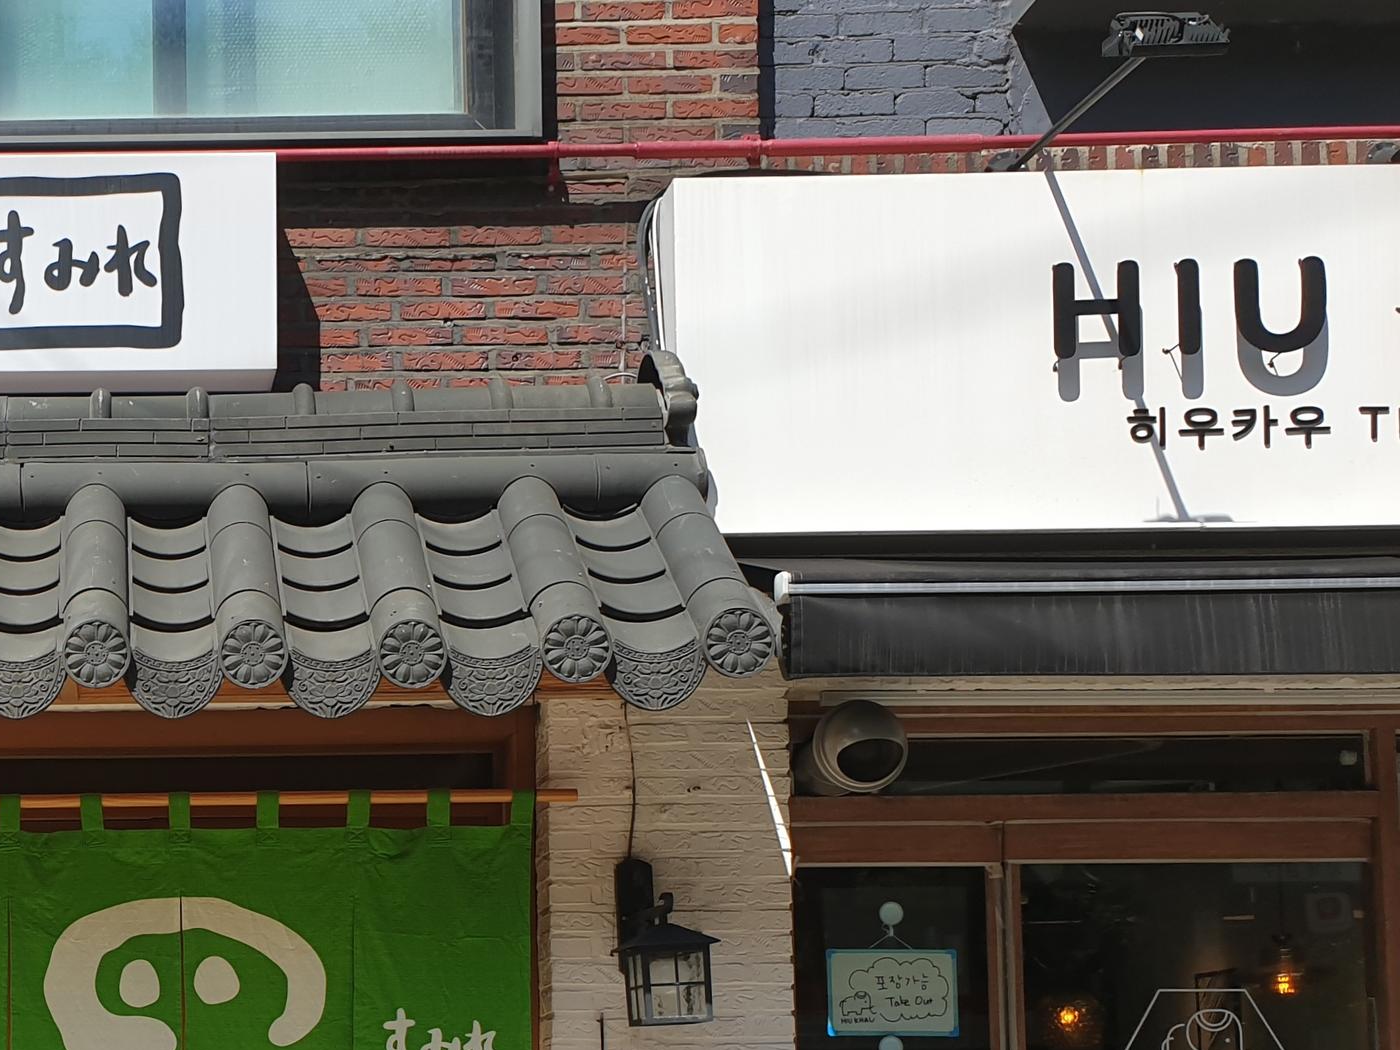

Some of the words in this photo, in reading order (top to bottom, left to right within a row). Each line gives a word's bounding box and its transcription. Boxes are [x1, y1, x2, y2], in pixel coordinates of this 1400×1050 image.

[1052, 256, 1328, 359] HIU
[1126, 405, 1331, 450] 히우카우
[875, 973, 929, 991] 포장가능
[885, 996, 911, 1008] Take
